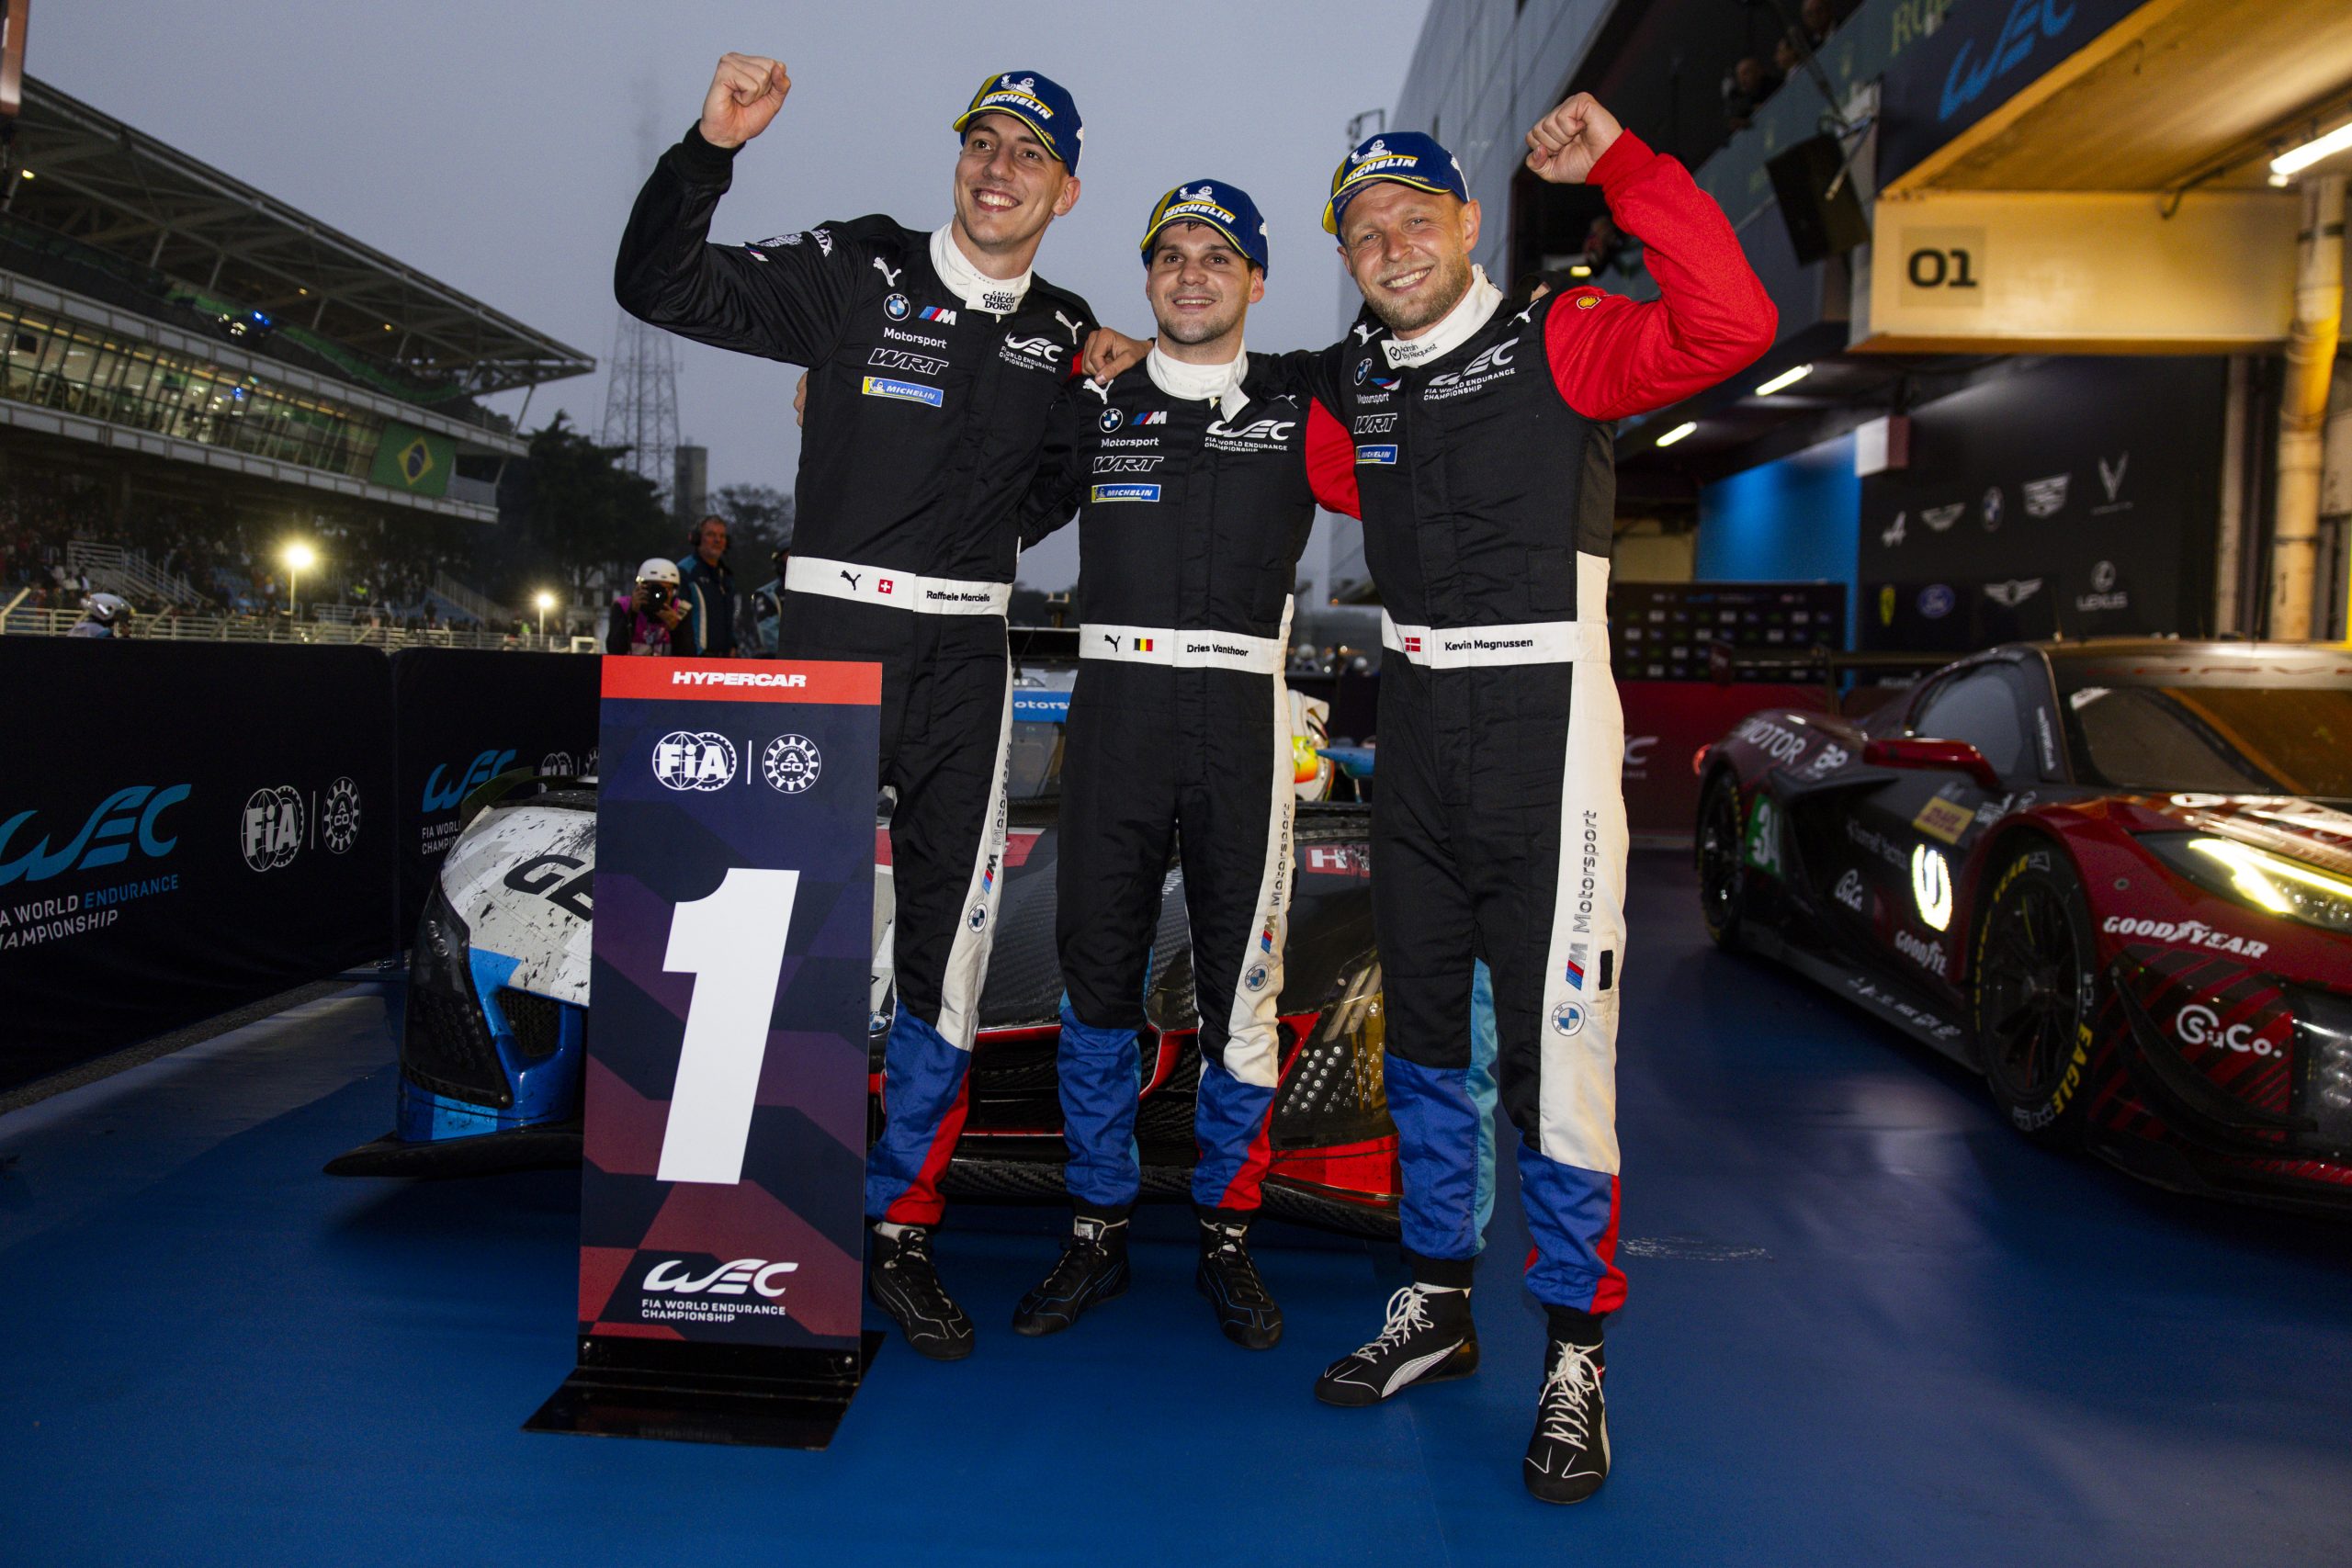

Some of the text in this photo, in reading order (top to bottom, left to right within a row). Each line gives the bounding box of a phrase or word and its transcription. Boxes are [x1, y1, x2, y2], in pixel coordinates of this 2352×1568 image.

[979, 94, 1052, 120] MICHELIN
[1161, 203, 1234, 224] MICHELIN
[1907, 248, 1978, 288] 01
[883, 327, 947, 349] Motorsport
[867, 347, 950, 376] WRT
[1023, 356, 1057, 374] ENDURANCE
[1465, 367, 1516, 385] ENDURANCE
[887, 384, 936, 400] MICHELIN
[1423, 384, 1483, 401] CHAMPIONSHIP
[1353, 412, 1398, 434] WRT
[1101, 436, 1160, 448] Motorsport
[1244, 442, 1288, 451] ENDURANCE
[1092, 456, 1164, 474] WRT
[1106, 489, 1153, 497] MICHELIN
[926, 590, 990, 603] Raffaele Marciello
[1186, 644, 1249, 657] Dries Vanthoor
[1444, 638, 1533, 651] Kevin Magnussen
[672, 671, 807, 688] HYPERCAR
[422, 825, 435, 840] FIA
[1571, 809, 1598, 934] Motorsport
[14, 894, 79, 924] WORLD
[84, 874, 180, 909] ENDURANCE
[2102, 915, 2269, 961] GOODYEAR
[655, 867, 800, 1185] 1
[2050, 1021, 2095, 1116] EAGLE
[642, 1258, 799, 1298] WEC
[641, 1299, 786, 1315] FIA WORLD ENDURANCE
[641, 1309, 736, 1323] CHAMPIONSHIP
